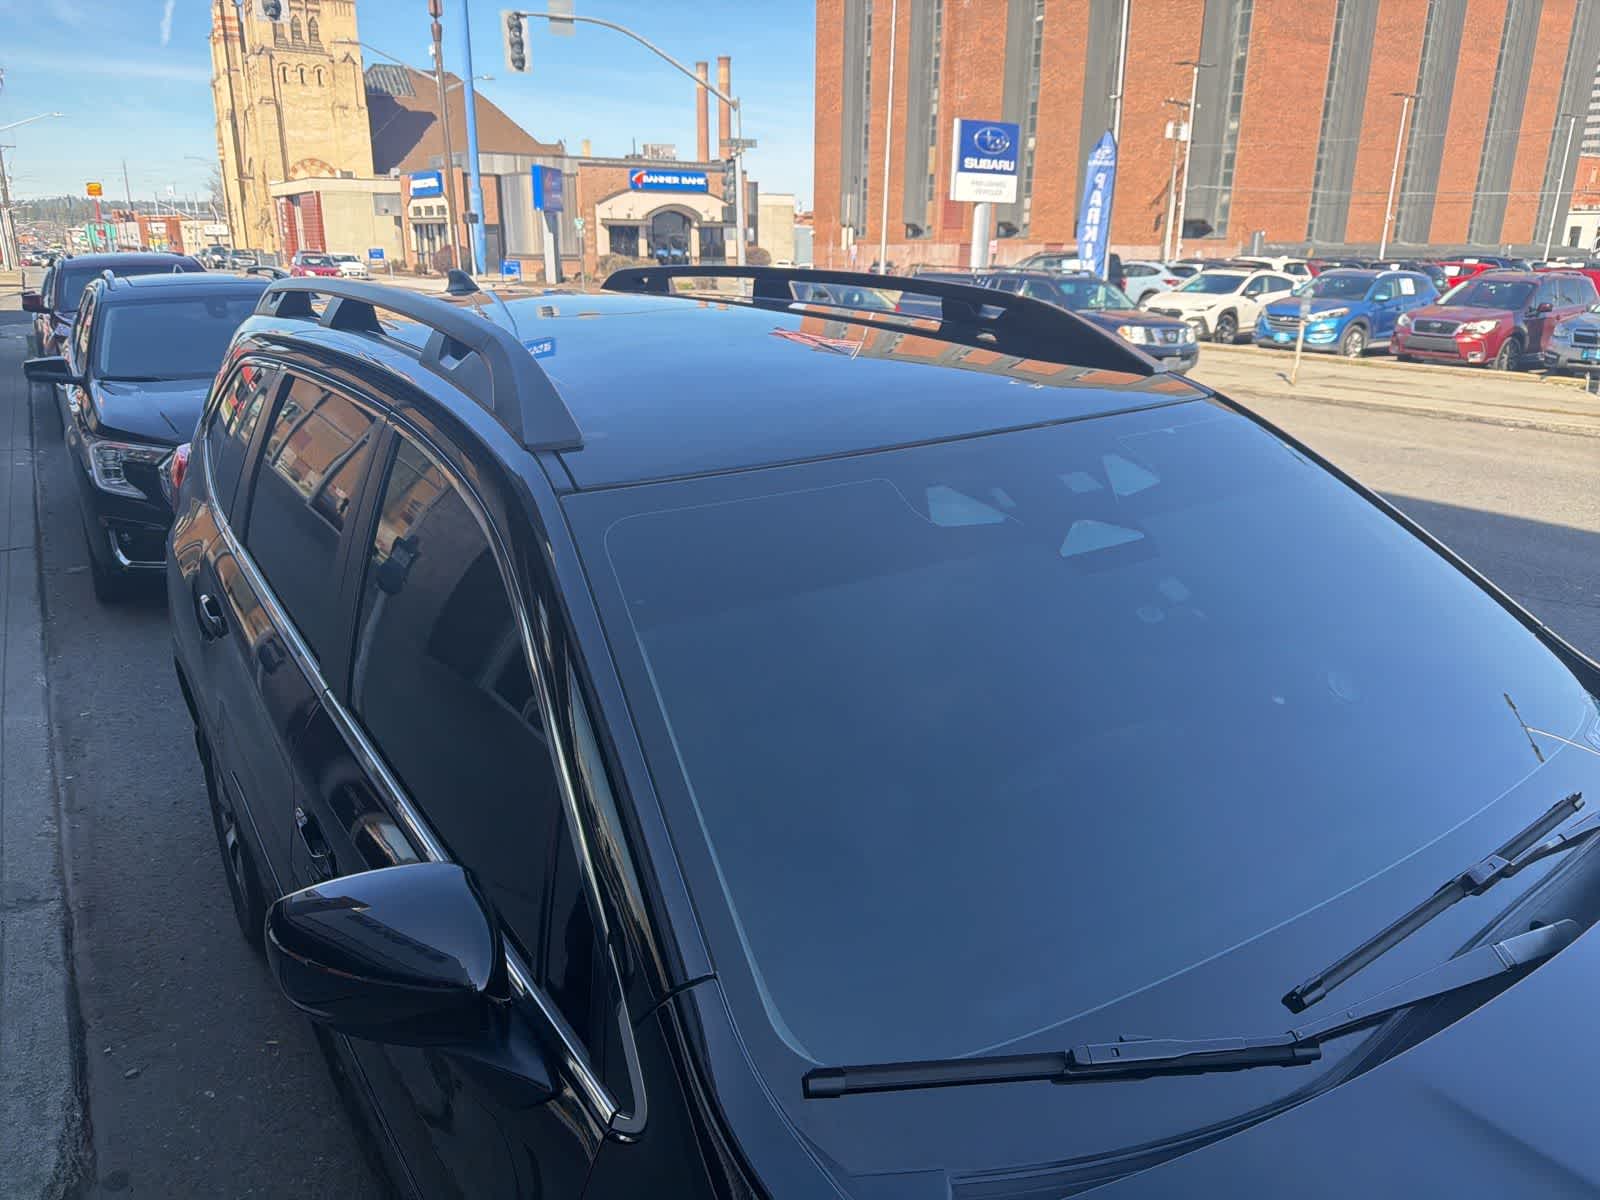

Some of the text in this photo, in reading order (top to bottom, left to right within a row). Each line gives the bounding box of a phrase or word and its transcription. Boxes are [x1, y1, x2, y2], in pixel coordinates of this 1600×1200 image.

[964, 157, 1015, 171] SUBARU
[643, 174, 706, 185] BANNER BANK
